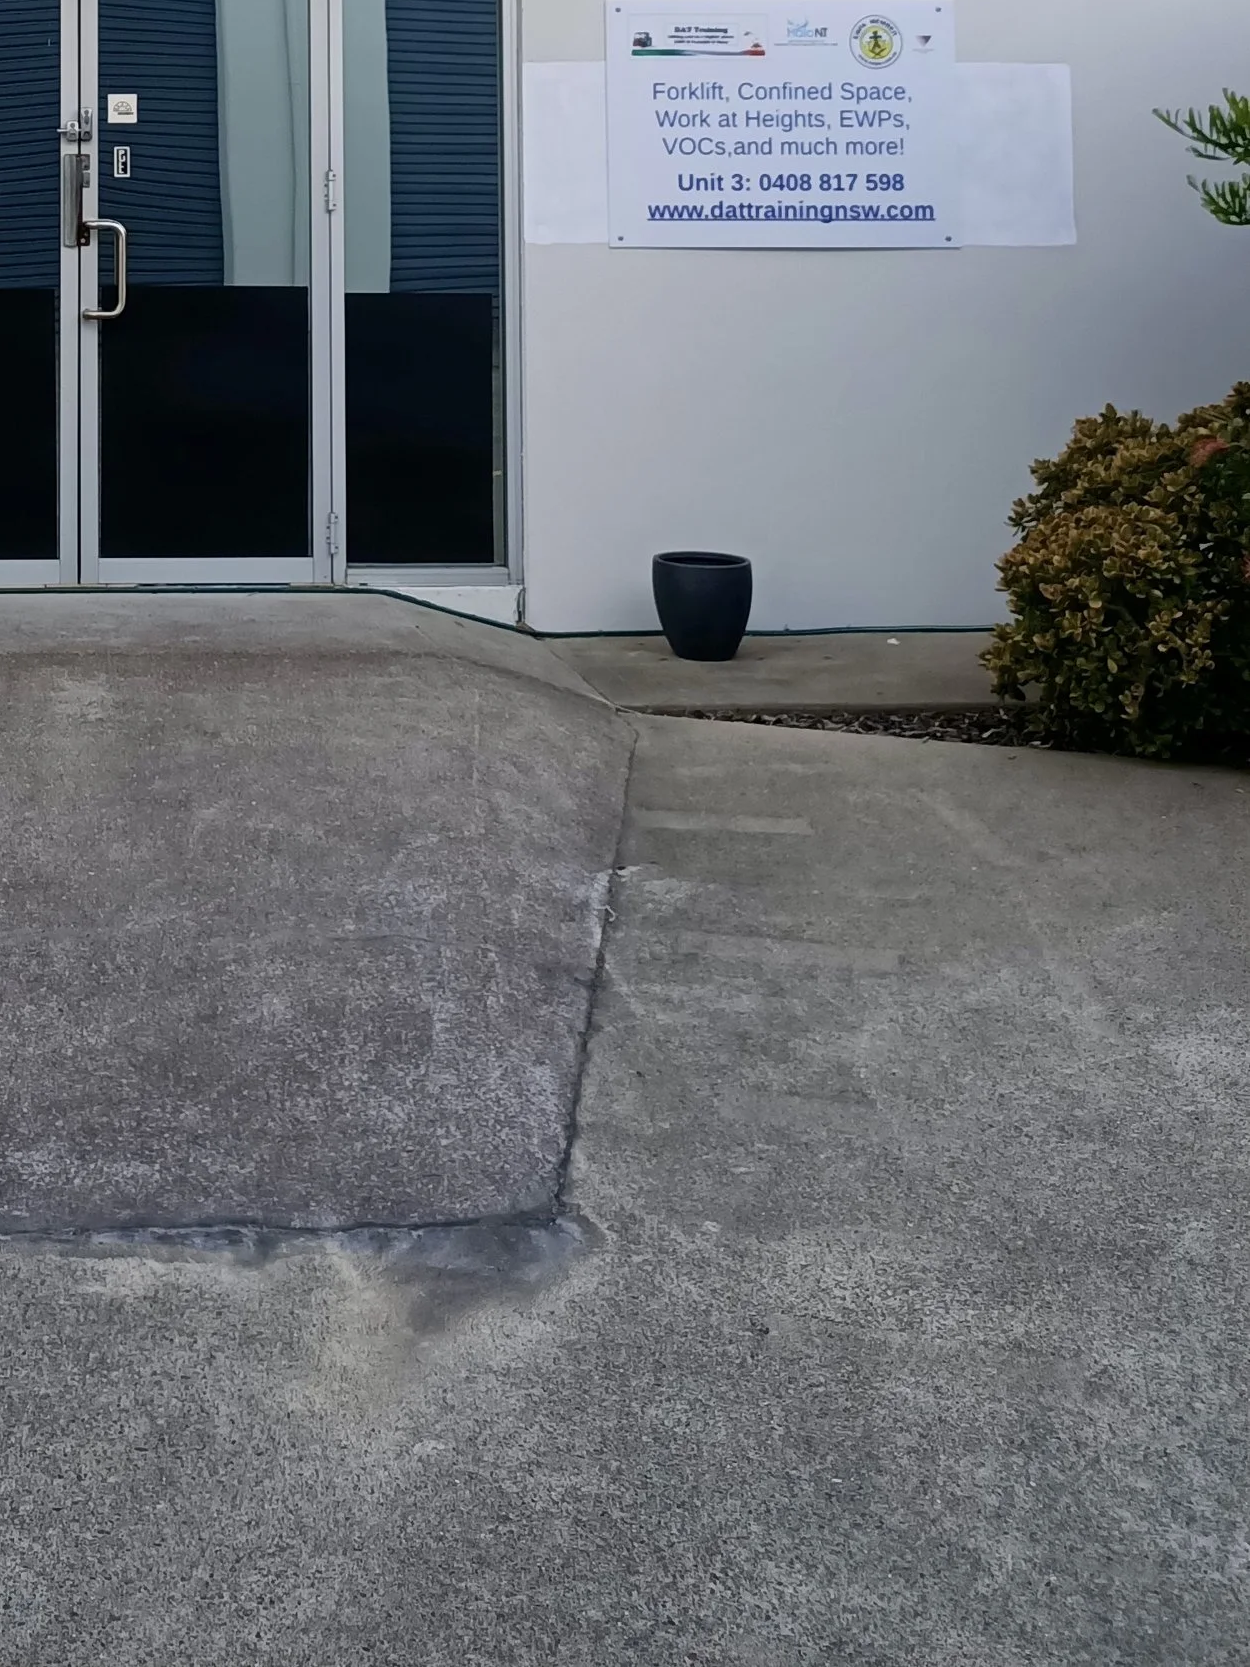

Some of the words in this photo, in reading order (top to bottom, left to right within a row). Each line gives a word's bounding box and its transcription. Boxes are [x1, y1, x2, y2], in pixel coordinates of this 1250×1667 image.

[652, 82, 730, 104] Forklift,
[737, 81, 833, 101] Confined
[840, 82, 912, 104] Space,
[655, 110, 711, 128] Work
[718, 112, 737, 128] at
[745, 110, 831, 133] Heights,
[839, 110, 911, 131] EWPs,
[780, 137, 838, 155] much
[845, 137, 905, 155] more!
[678, 173, 724, 191] Unit
[731, 173, 751, 191] 3:
[758, 173, 813, 191] 0408
[819, 173, 857, 191] 817
[865, 173, 905, 191] 598
[647, 200, 935, 223] www.dattrainingnsw.com
